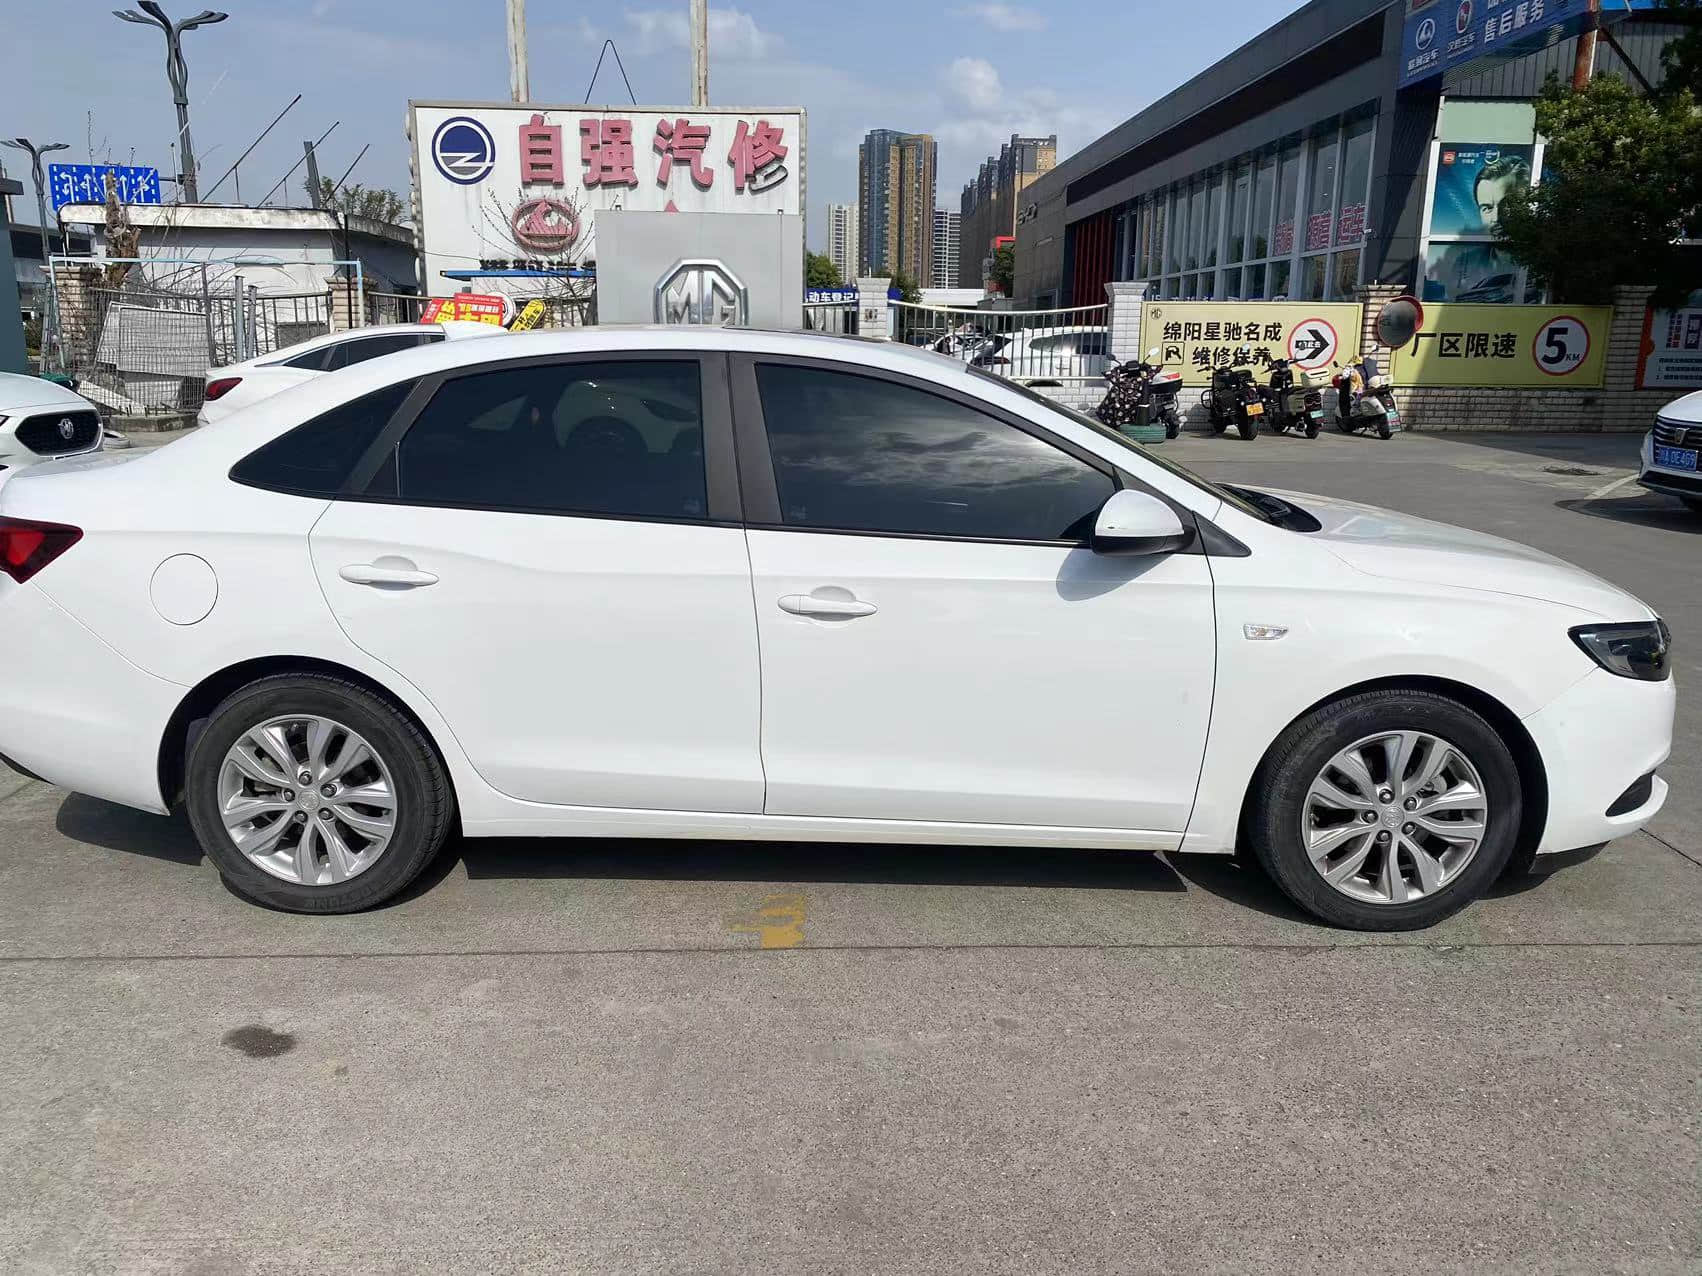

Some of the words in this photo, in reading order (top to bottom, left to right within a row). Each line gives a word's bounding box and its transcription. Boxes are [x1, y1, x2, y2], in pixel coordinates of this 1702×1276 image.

[1485, 0, 1544, 43] 售后服务
[519, 113, 788, 191] 自强汽修
[1162, 321, 1282, 342] 绵阳星驰名成
[1411, 332, 1517, 358] 厂区限速
[1541, 327, 1569, 365] 5
[1565, 353, 1580, 362] KM
